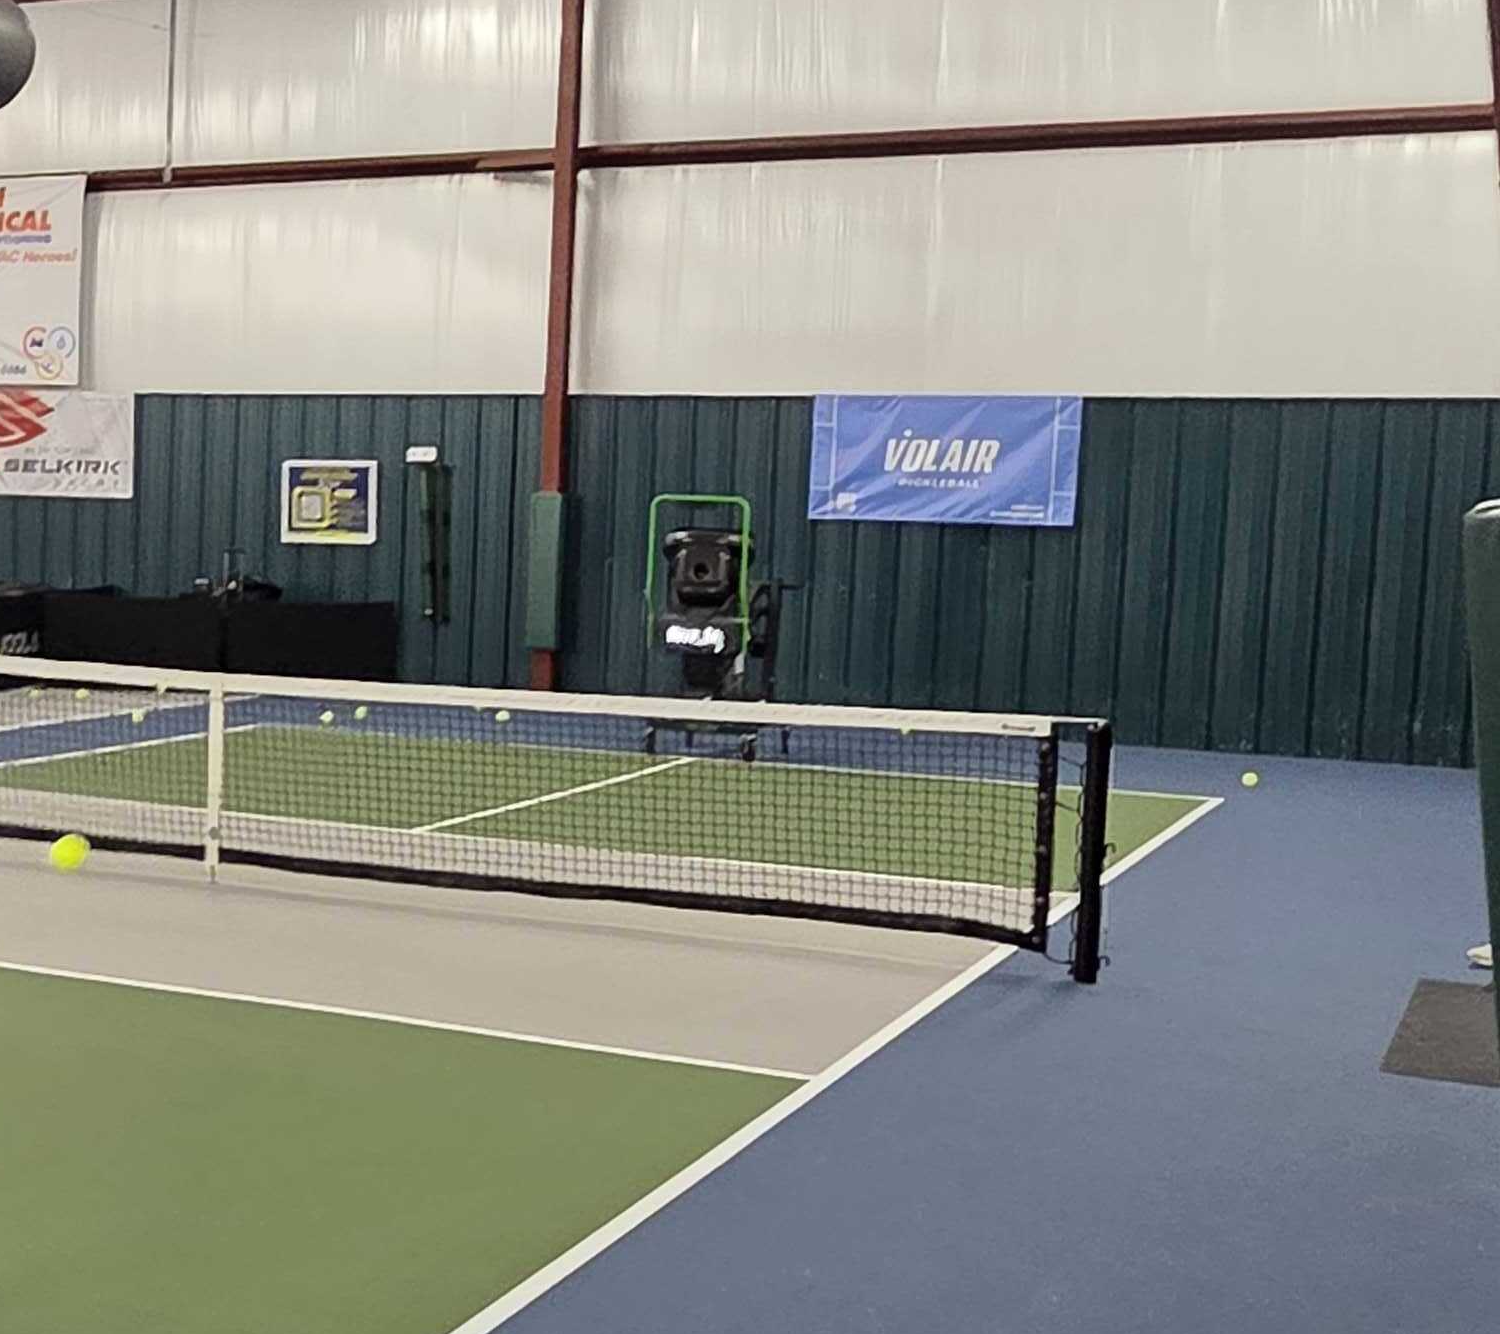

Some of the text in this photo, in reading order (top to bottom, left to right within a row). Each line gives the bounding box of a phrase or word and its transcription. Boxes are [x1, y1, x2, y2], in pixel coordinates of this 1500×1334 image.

[22, 248, 78, 263] Heroes!
[884, 436, 1000, 474] VOLAIR
[3, 459, 122, 475] SELKIRK
[897, 478, 980, 489] PICKLEBALL
